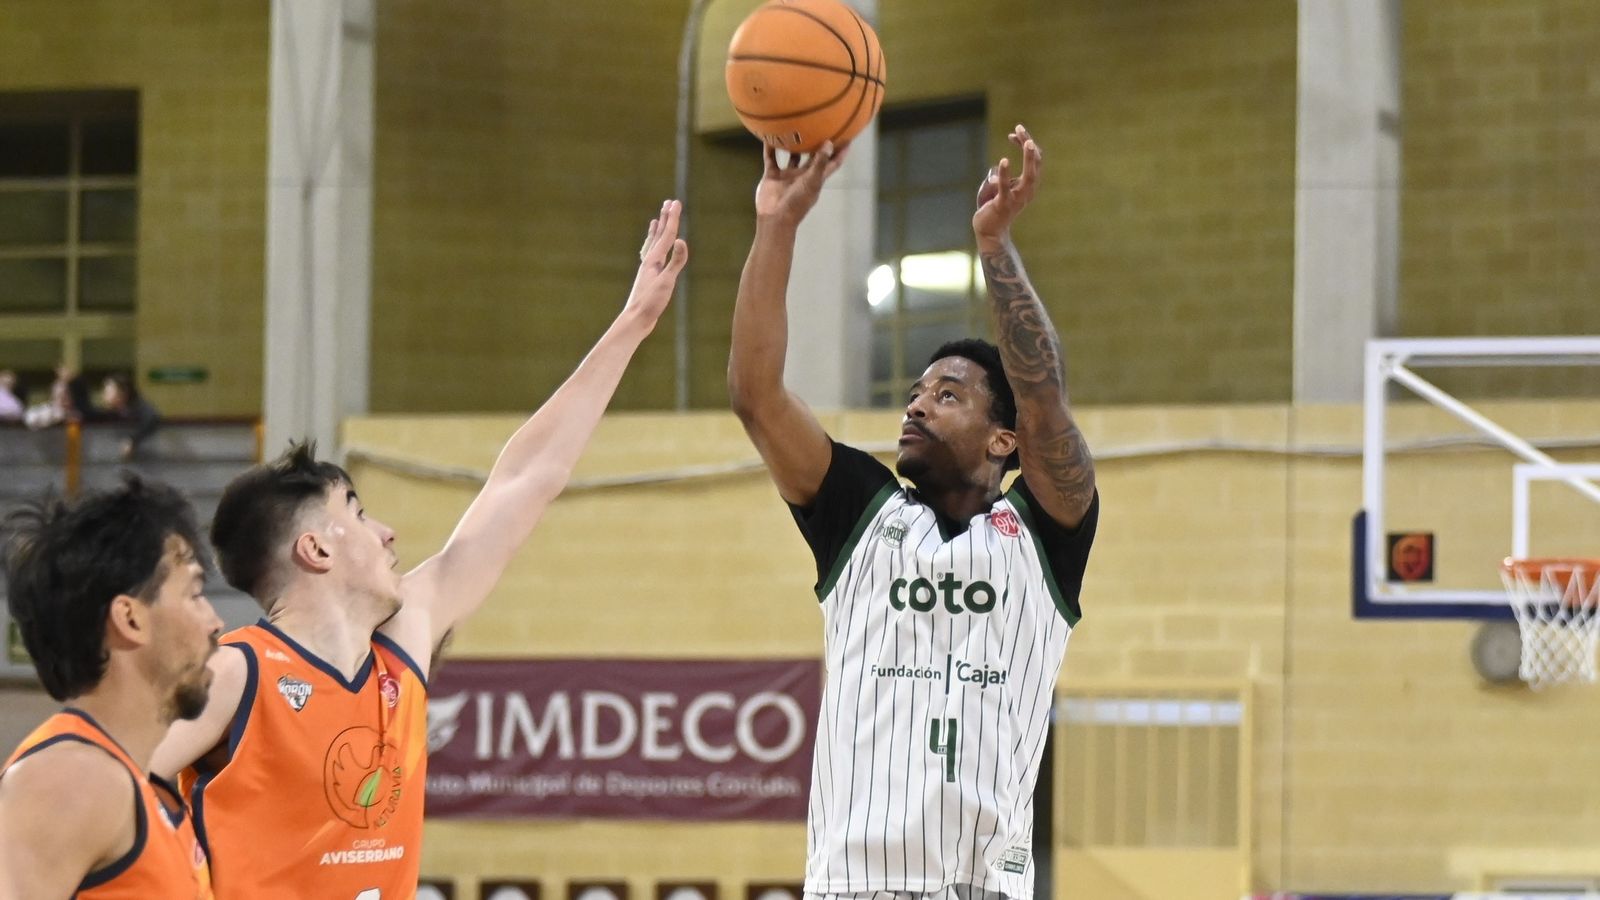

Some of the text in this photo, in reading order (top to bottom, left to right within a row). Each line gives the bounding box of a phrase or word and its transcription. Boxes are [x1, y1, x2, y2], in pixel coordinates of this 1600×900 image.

[889, 572, 996, 614] coto
[871, 664, 942, 680] Fundación
[474, 690, 807, 763] IMDECO
[929, 718, 957, 782] 4
[320, 846, 404, 866] AVISERRANO
[352, 839, 386, 850] GRUPO
